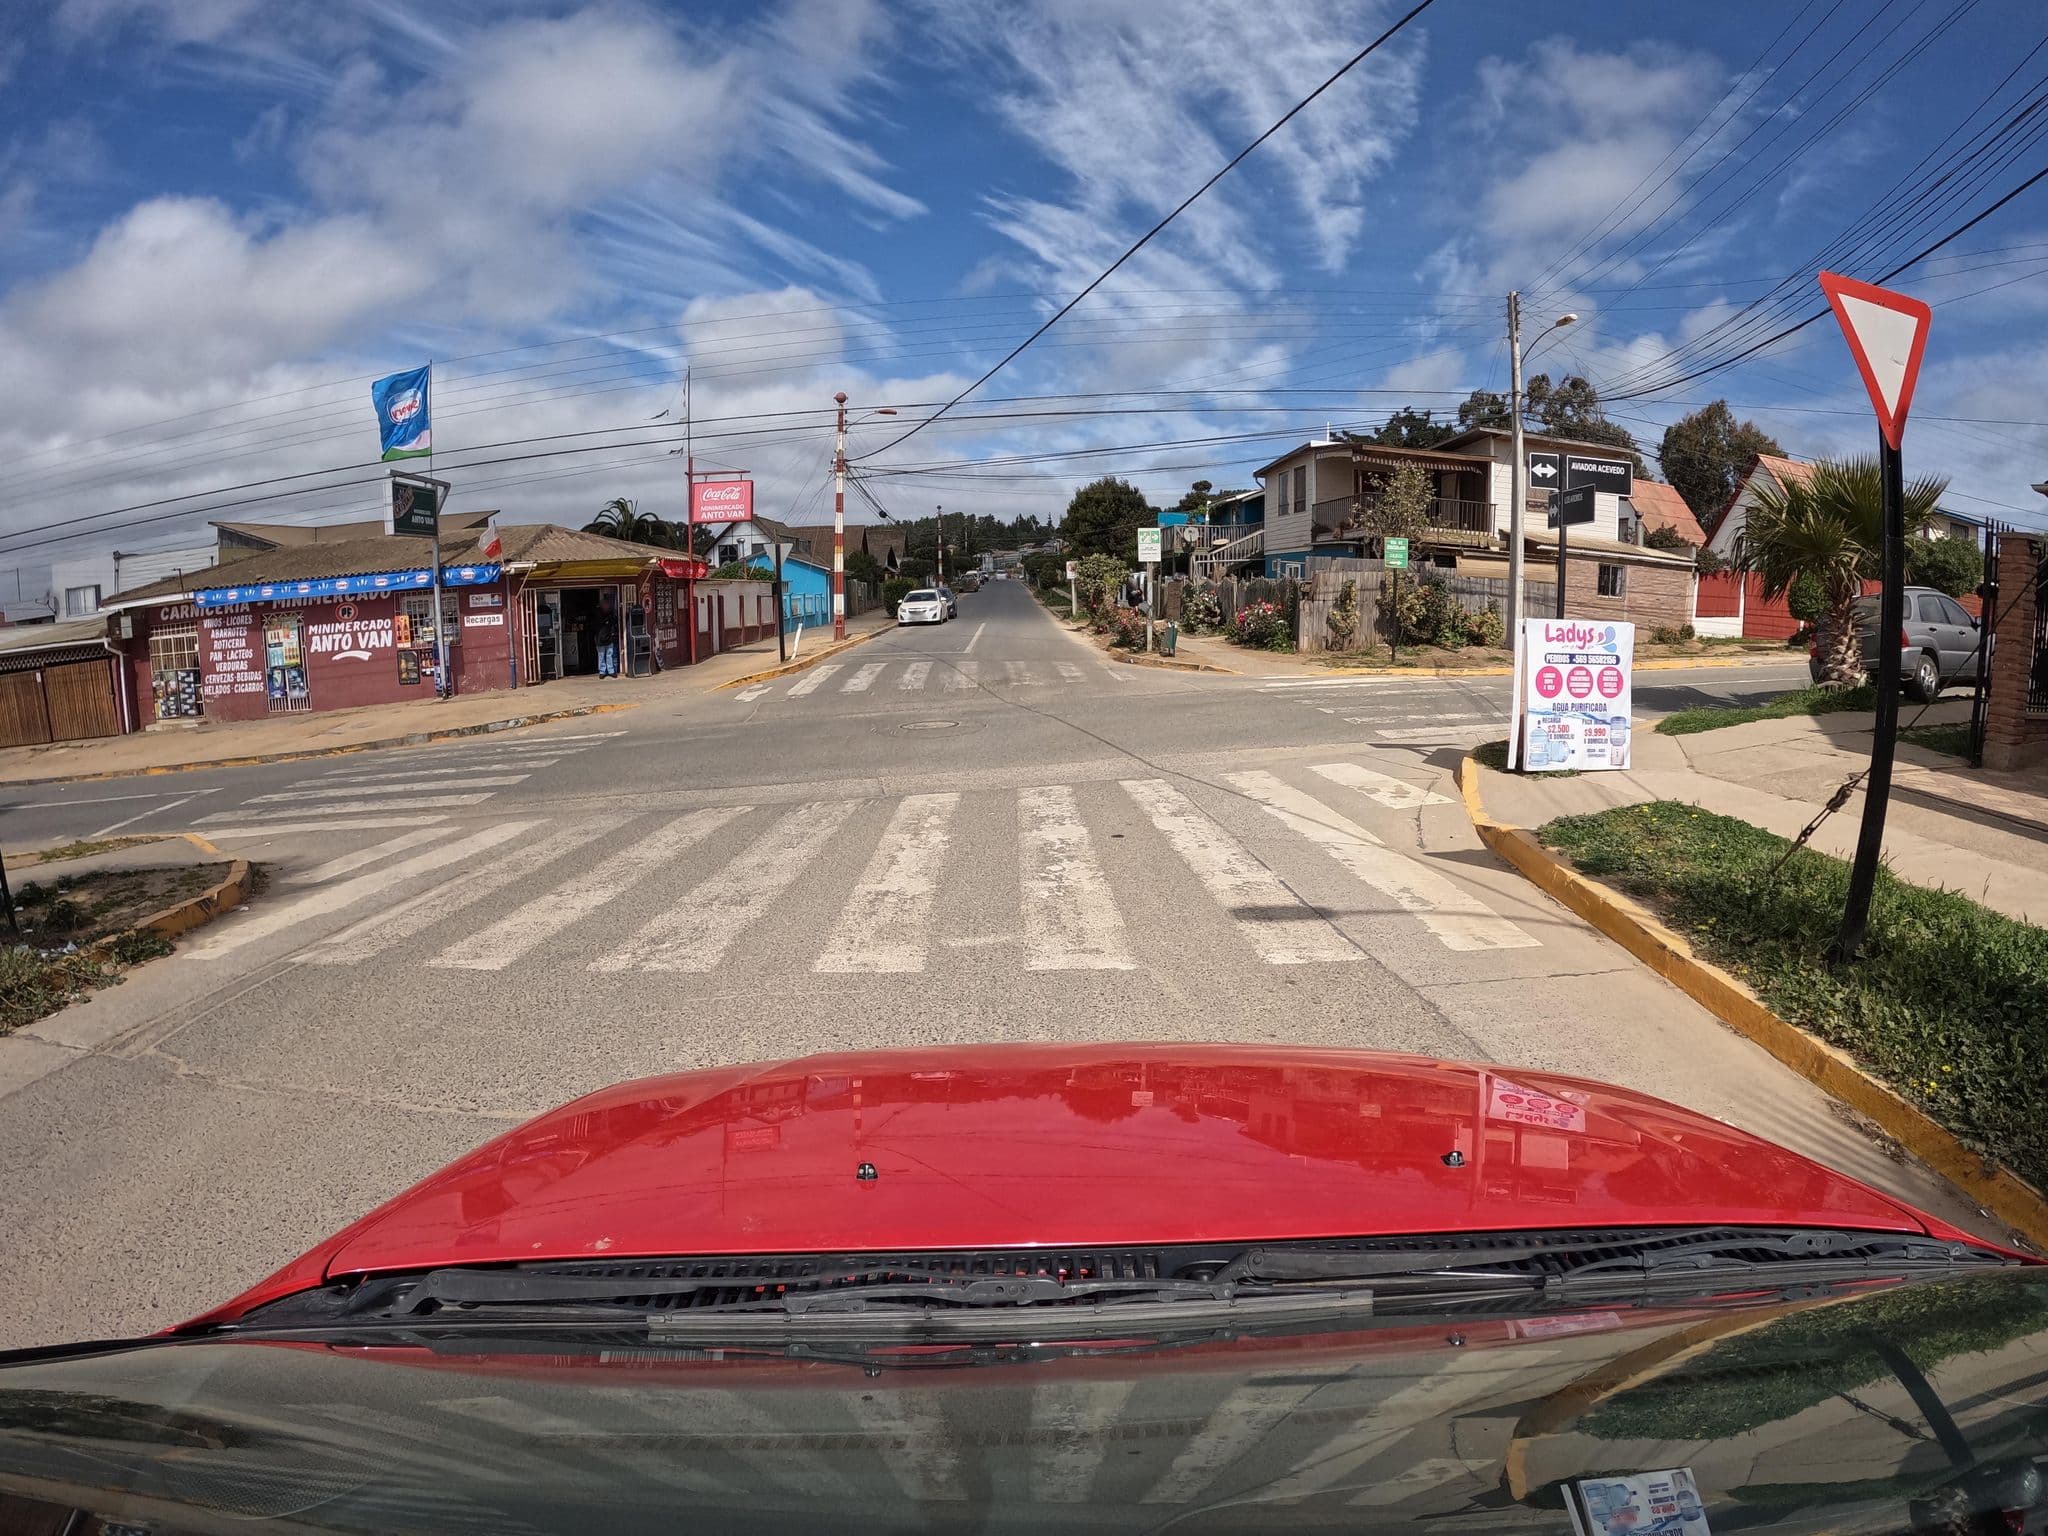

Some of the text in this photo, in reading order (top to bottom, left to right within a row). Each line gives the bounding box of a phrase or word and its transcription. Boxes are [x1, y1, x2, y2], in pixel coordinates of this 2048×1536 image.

[1571, 462, 1625, 475] AVIADOR ACEVEDO
[702, 486, 743, 501] Coca-Cola
[700, 503, 745, 512] MINIMERCADO
[701, 510, 745, 519] ANTO VAN
[203, 614, 253, 629] VINOS LICORES
[466, 615, 501, 625] Recargas
[210, 627, 248, 639] ABARROTES
[308, 618, 392, 636] MINIMERCADO
[310, 629, 393, 653] ANTO VAN
[1545, 623, 1594, 650] Ladys
[213, 638, 246, 650] ROTICERIA
[209, 649, 253, 662] PAN LACTEOS
[1546, 654, 1570, 664] PEDIDOS
[215, 661, 248, 672] VERDURAS
[205, 671, 262, 684] CERVEZAS BEBIDAS
[204, 684, 231, 695] HELADOS
[234, 682, 264, 694] CIGARROS
[1552, 703, 1607, 712] AGUA PURIFICADA
[1547, 724, 1570, 734] $2.500
[1584, 727, 1607, 737] $9.990
